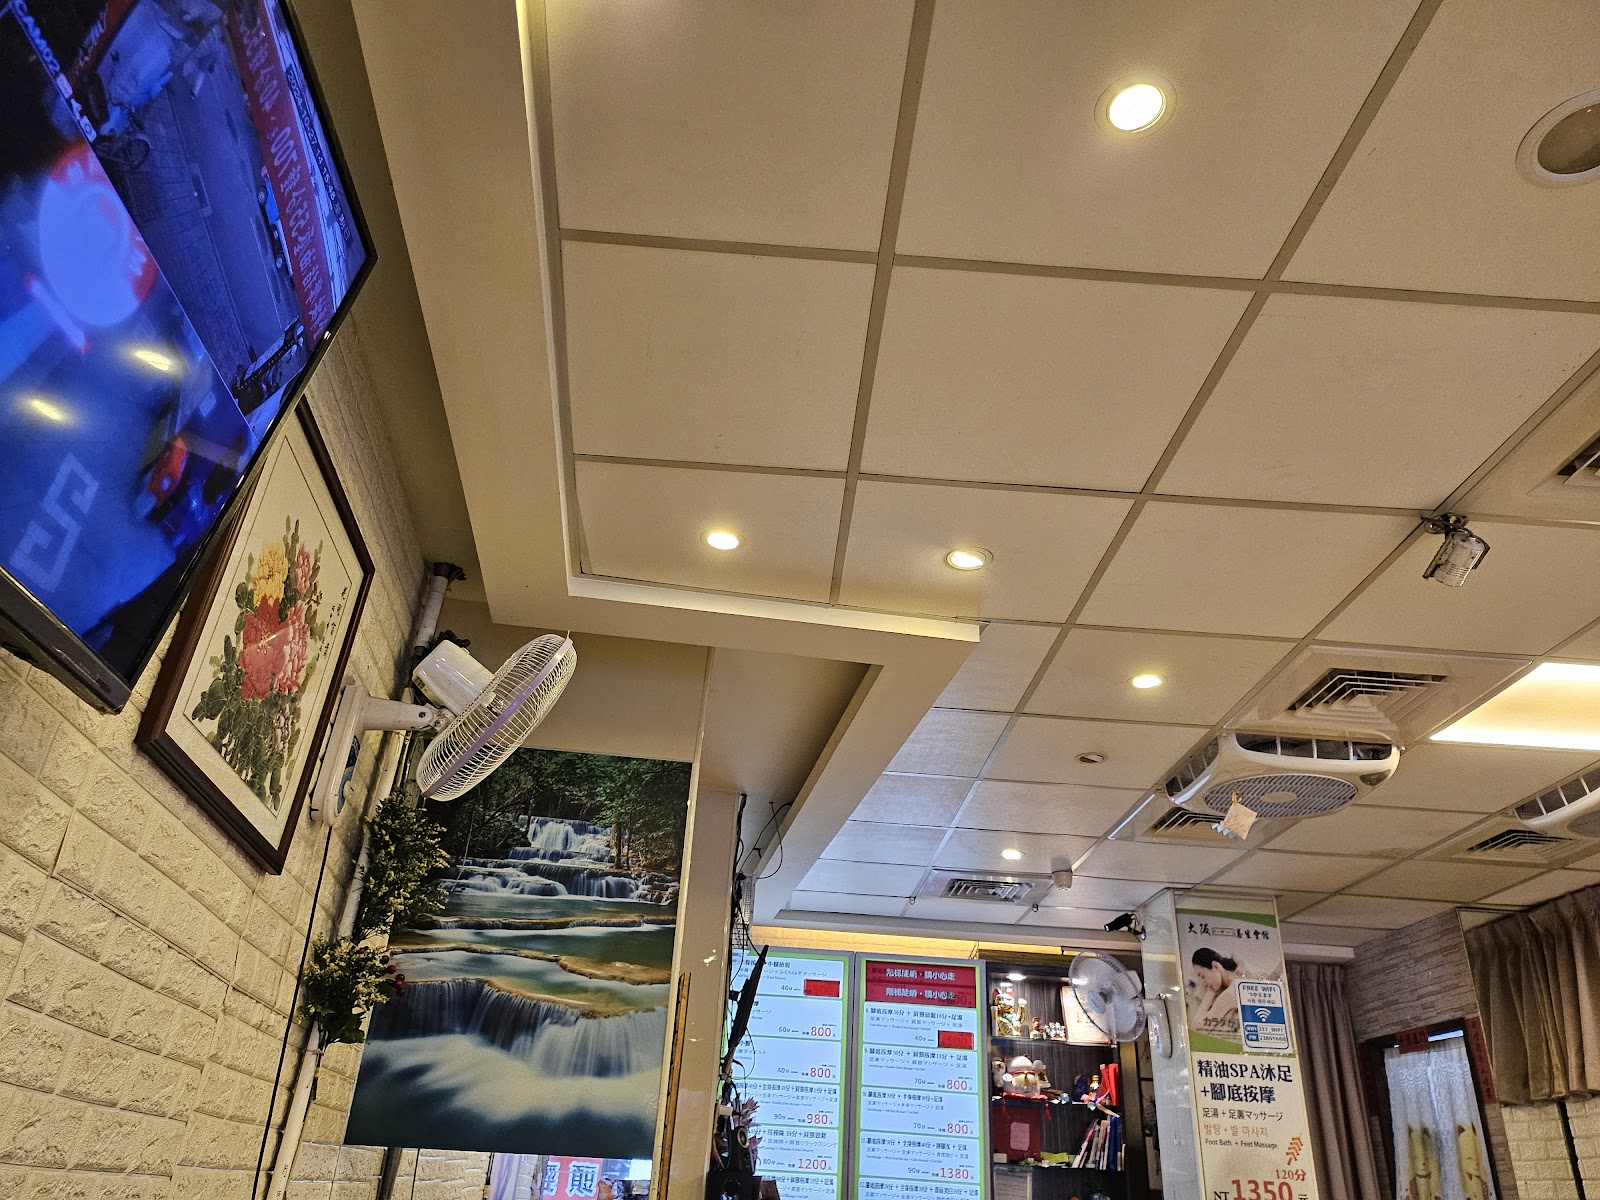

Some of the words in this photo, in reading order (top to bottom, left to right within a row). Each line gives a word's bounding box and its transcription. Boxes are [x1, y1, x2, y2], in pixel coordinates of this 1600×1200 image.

[286, 70, 318, 145] 2024-10-27
[1242, 985, 1259, 993] FREE
[811, 1026, 832, 1037] 800
[810, 1067, 831, 1079] 800
[1197, 1059, 1293, 1083] 精油SPA沐足
[946, 1079, 968, 1091] 800
[1200, 1082, 1276, 1104] +腳底按摩
[806, 1113, 828, 1125] 980
[1203, 1107, 1219, 1118] 足湯
[1228, 1109, 1283, 1121] 足裏マッサージ
[947, 1123, 969, 1134] 800
[1242, 1125, 1268, 1138] 마사지
[1205, 1138, 1218, 1146] Foot
[1253, 1141, 1278, 1150] Massage
[798, 1158, 827, 1170] 1200
[940, 1167, 969, 1180] 1380
[1275, 1168, 1306, 1181] 120分
[1213, 1191, 1230, 1200] NT
[1231, 1179, 1293, 1200] 1350
